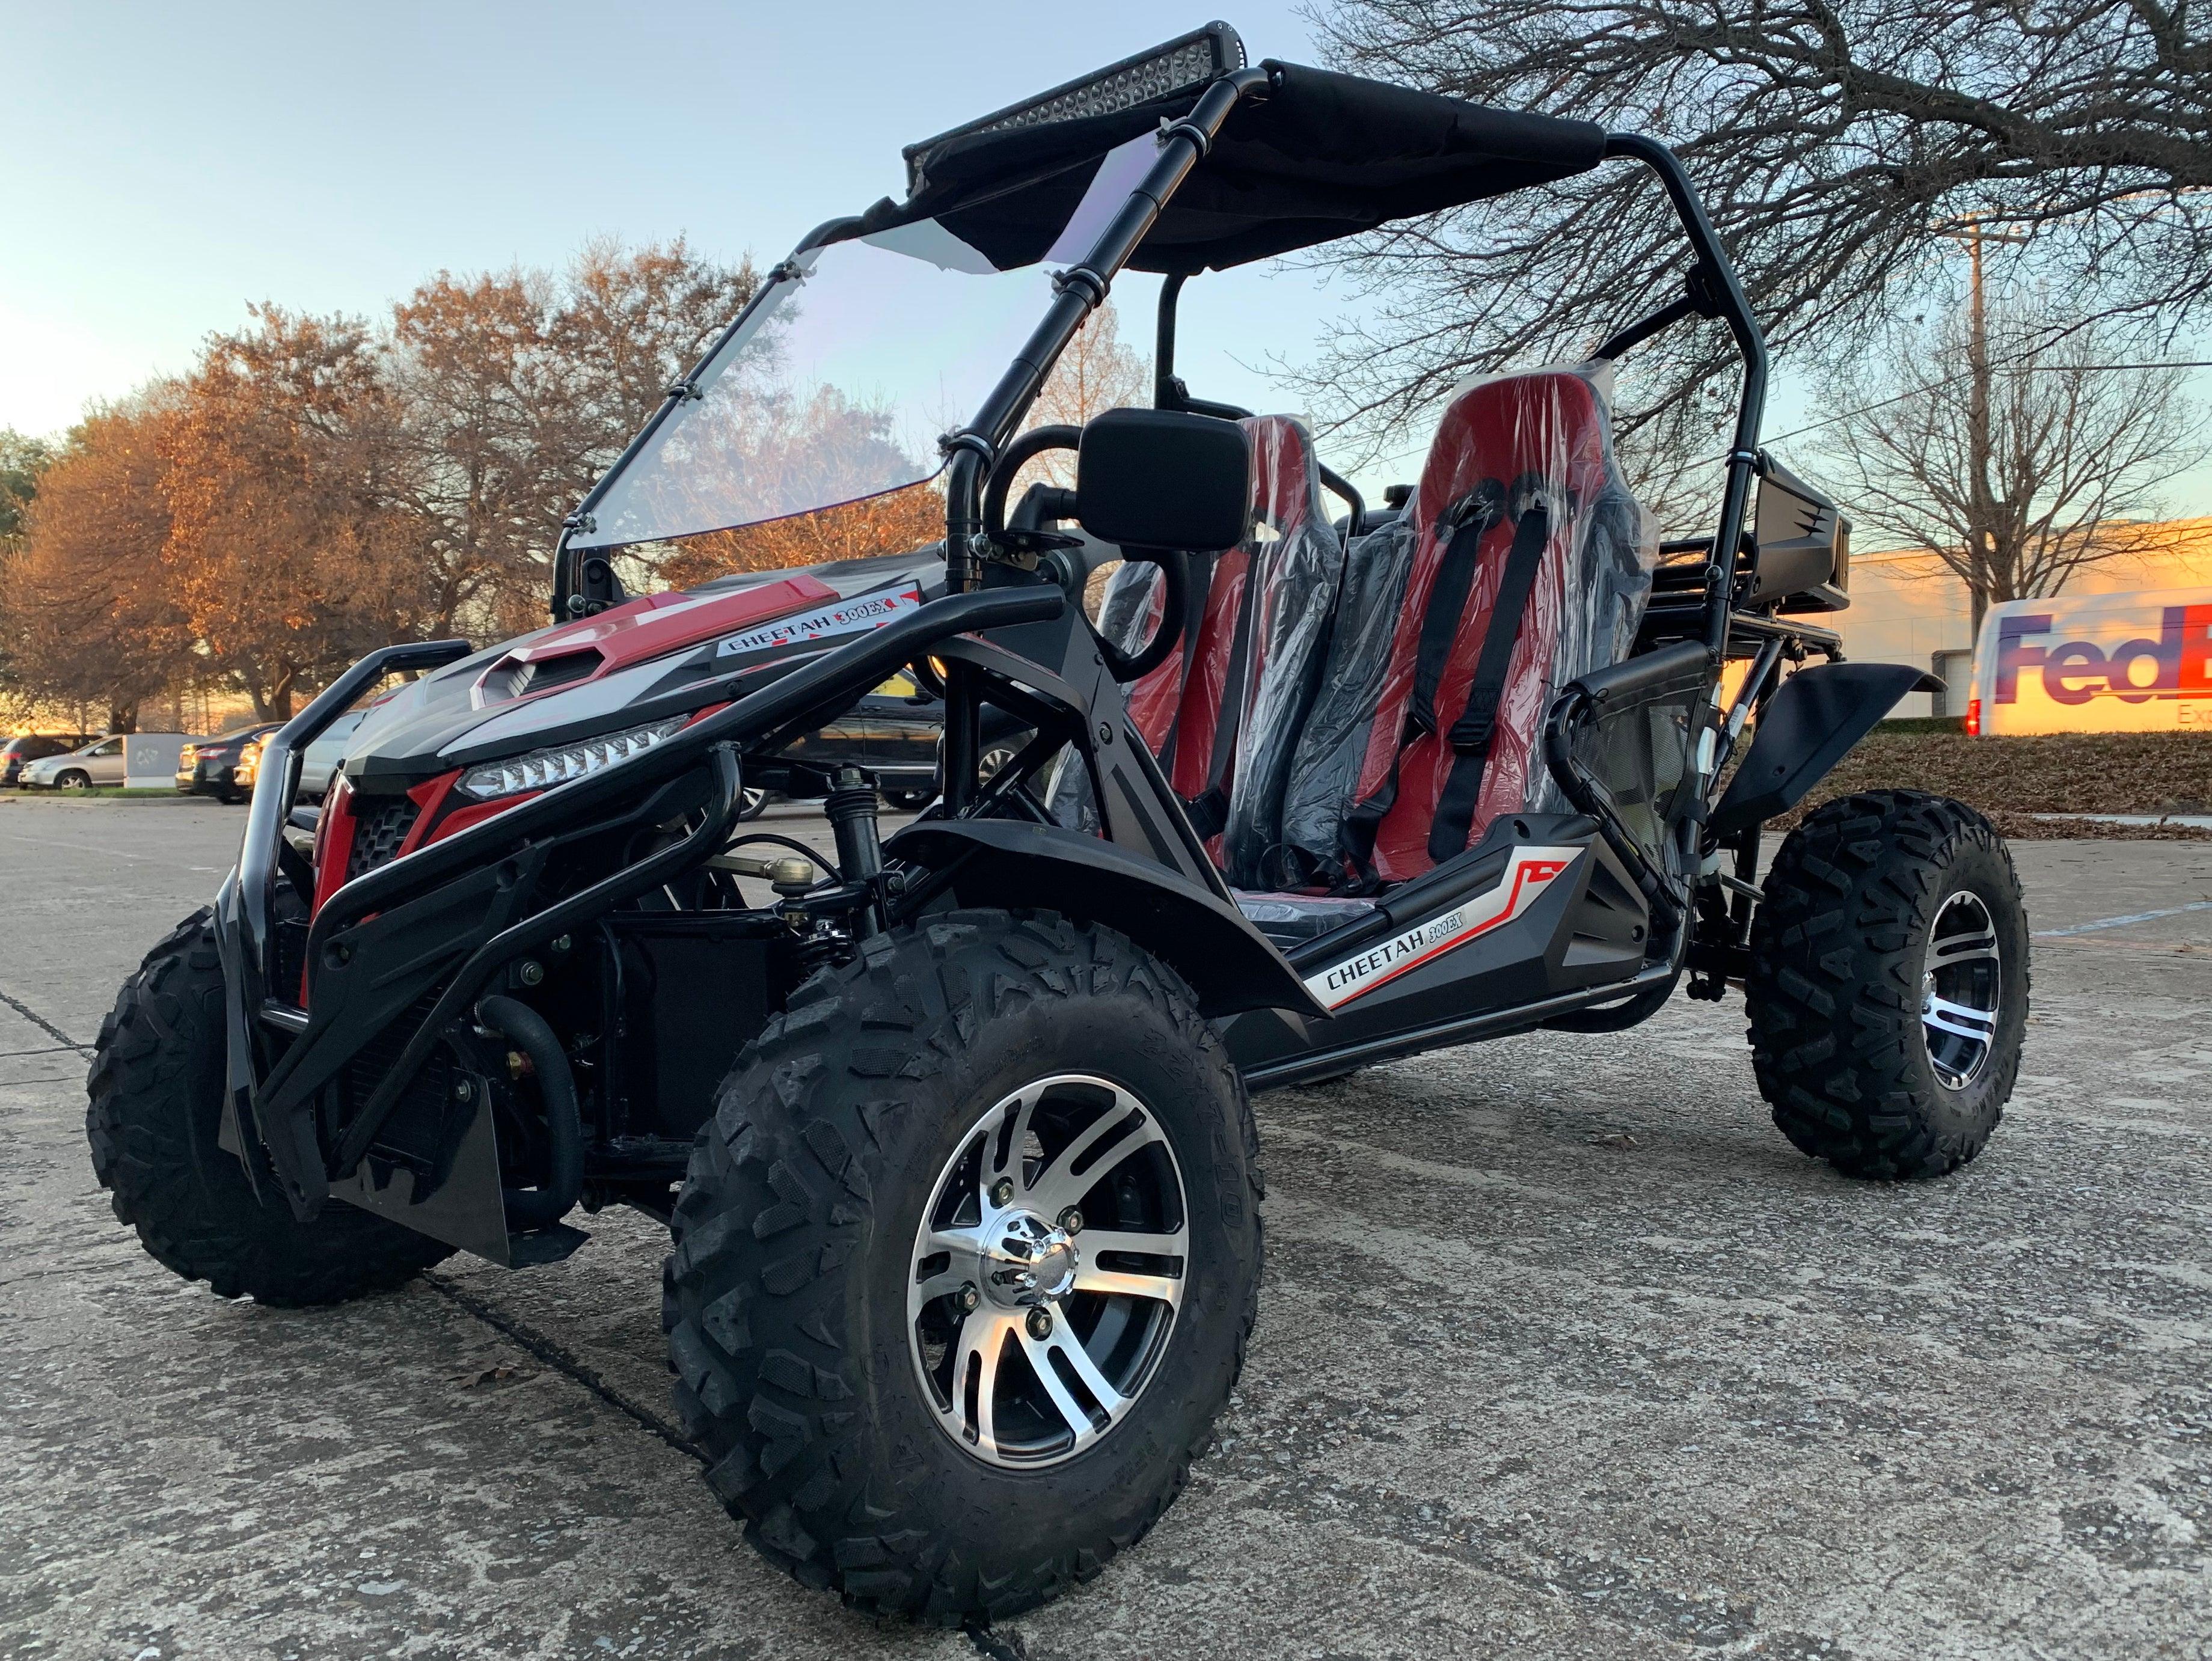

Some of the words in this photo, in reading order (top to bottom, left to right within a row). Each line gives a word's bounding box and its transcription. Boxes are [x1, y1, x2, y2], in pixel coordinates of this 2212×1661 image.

[728, 616, 830, 651] CHEETAH
[837, 598, 893, 625] 300EX
[1326, 930, 1424, 991] CHEETAH
[1429, 911, 1463, 944] 300EX
